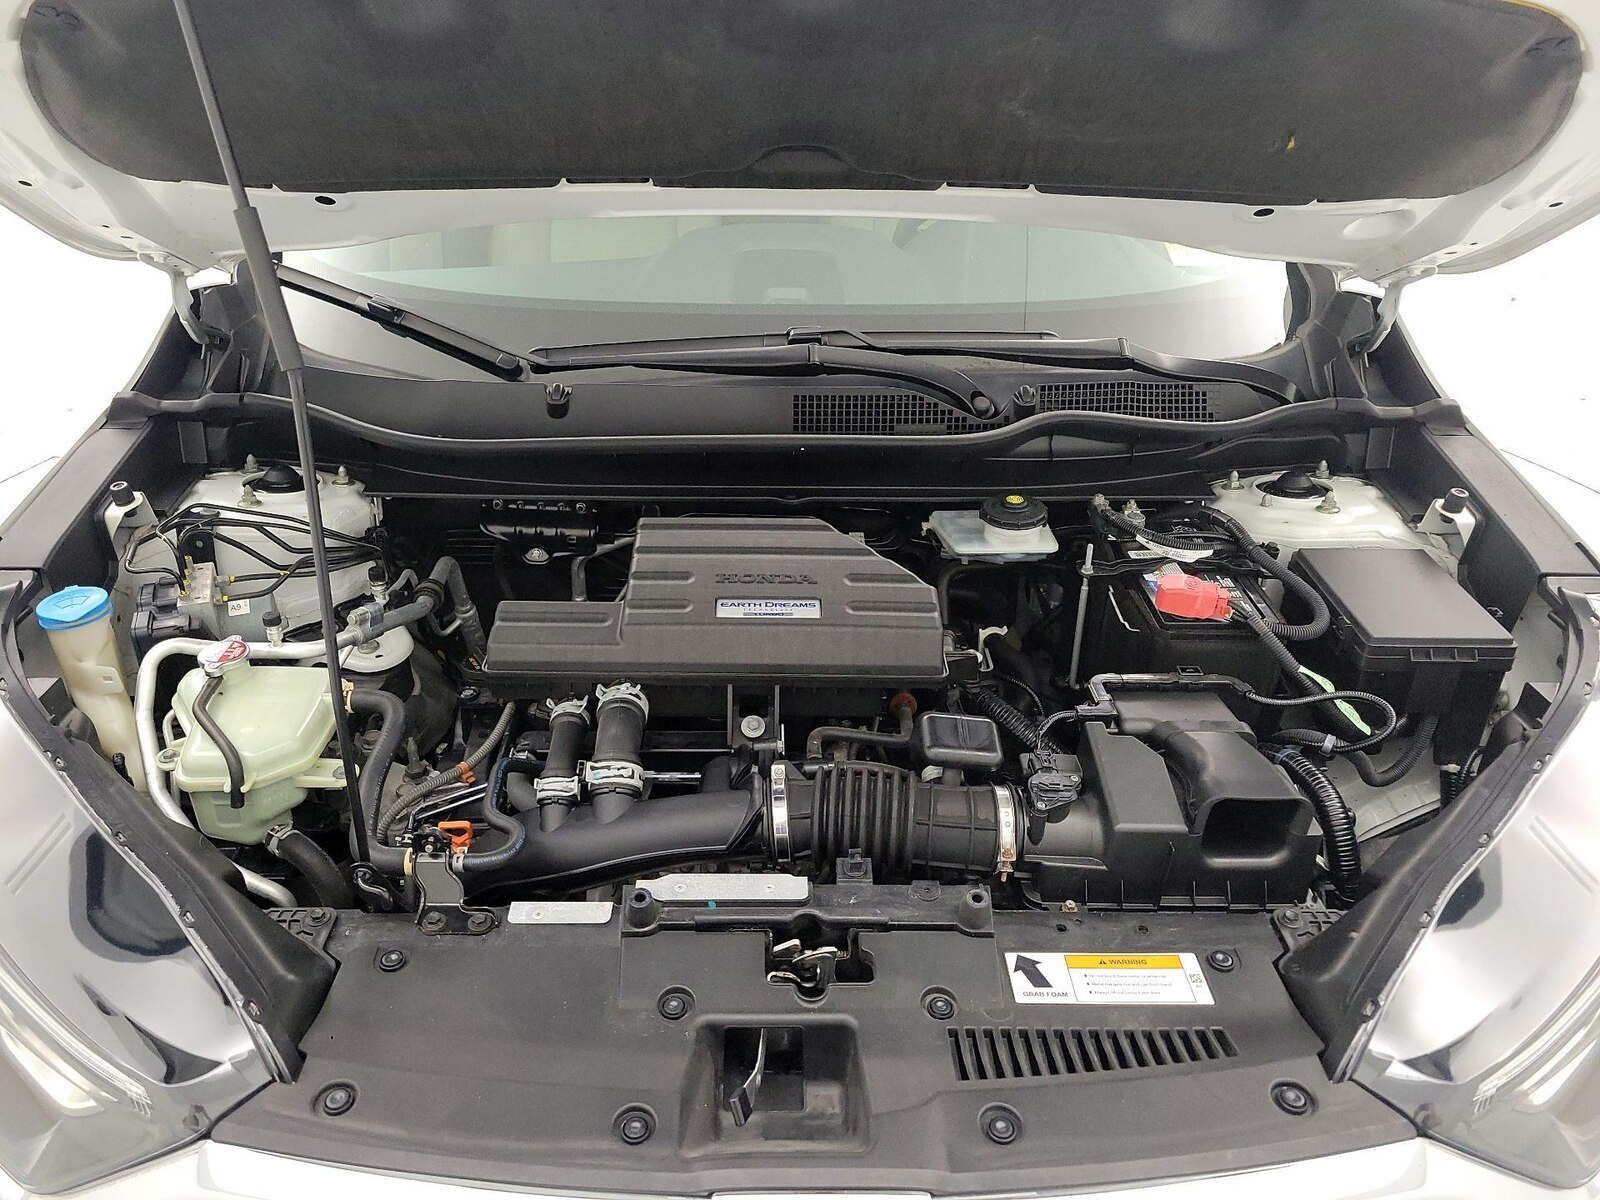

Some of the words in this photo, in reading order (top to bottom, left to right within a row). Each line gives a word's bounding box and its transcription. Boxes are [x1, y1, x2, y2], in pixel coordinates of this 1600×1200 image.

[715, 573, 819, 585] HONDA
[230, 603, 242, 612] A9
[1022, 990, 1045, 998] GRAB
[1046, 990, 1069, 998] FOAM
